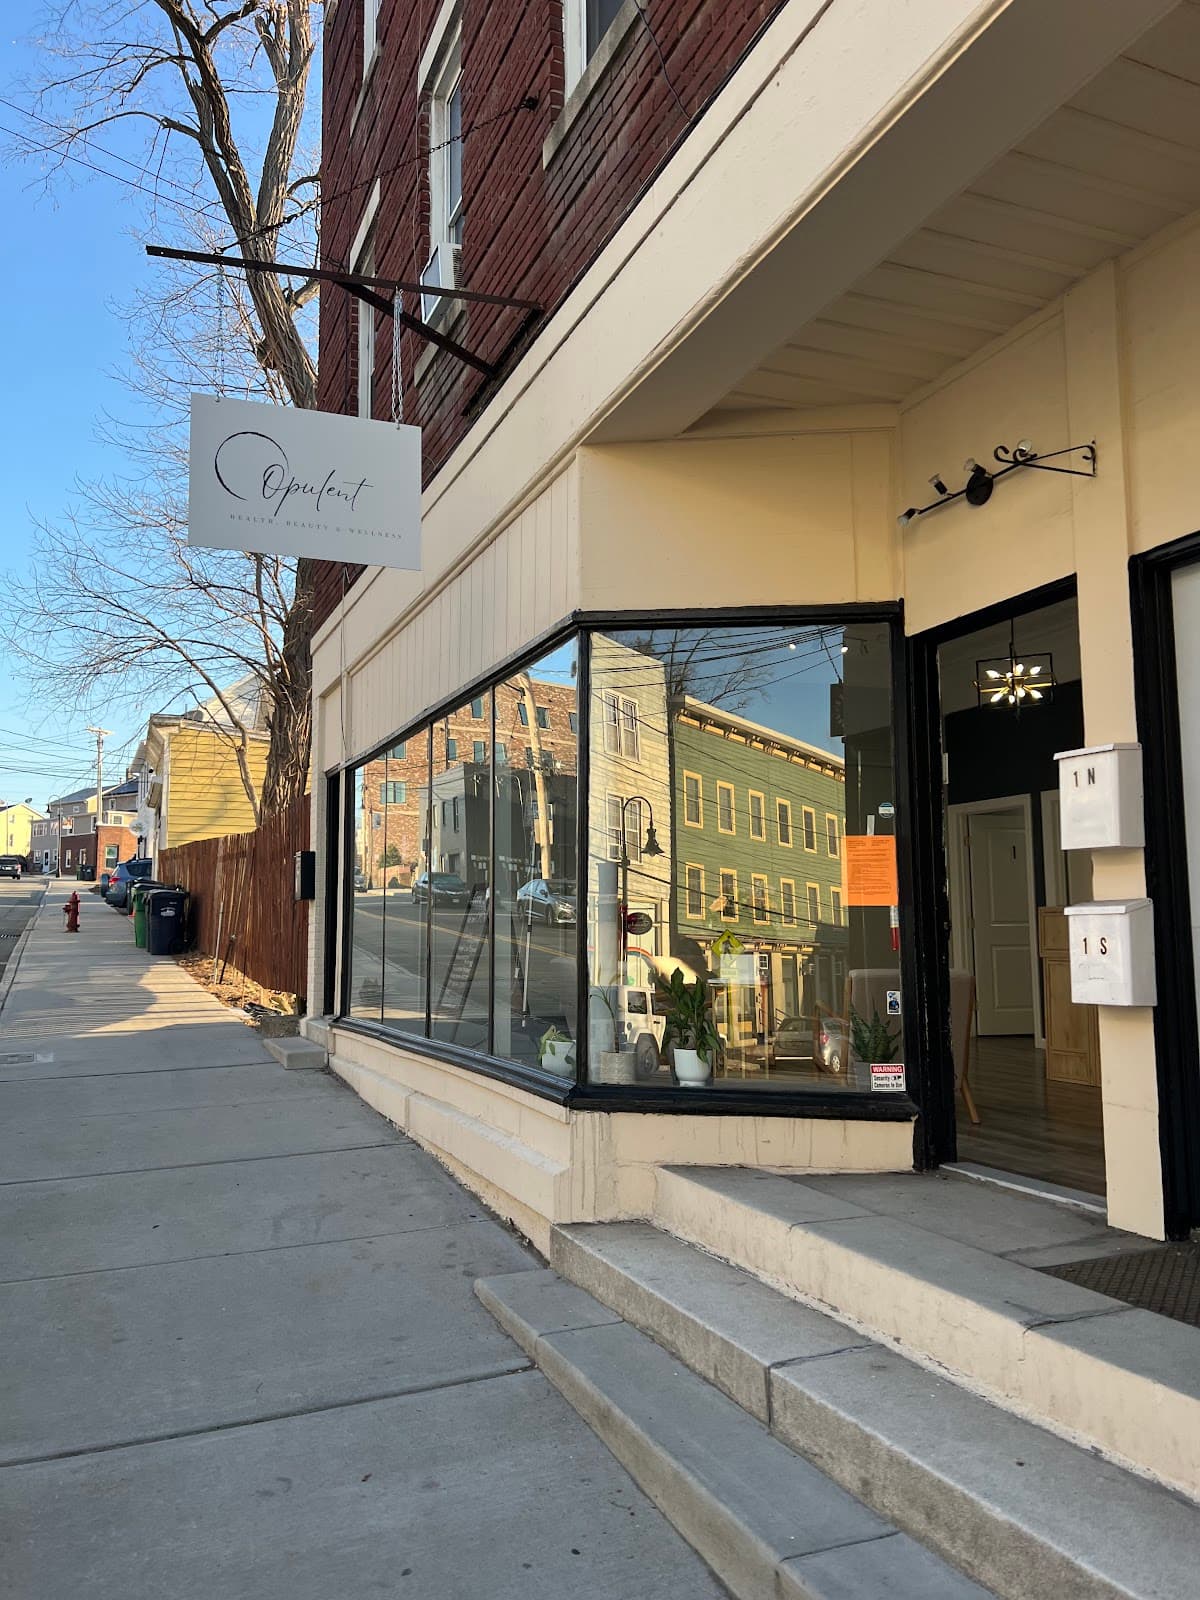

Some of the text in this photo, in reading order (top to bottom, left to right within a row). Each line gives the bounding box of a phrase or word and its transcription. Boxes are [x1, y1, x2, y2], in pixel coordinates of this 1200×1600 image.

[262, 463, 374, 517] Opulent
[286, 520, 329, 531] BEAUTY
[348, 527, 402, 540] WELLNESS
[1073, 767, 1096, 787] 1 N
[1082, 937, 1108, 955] 1 S
